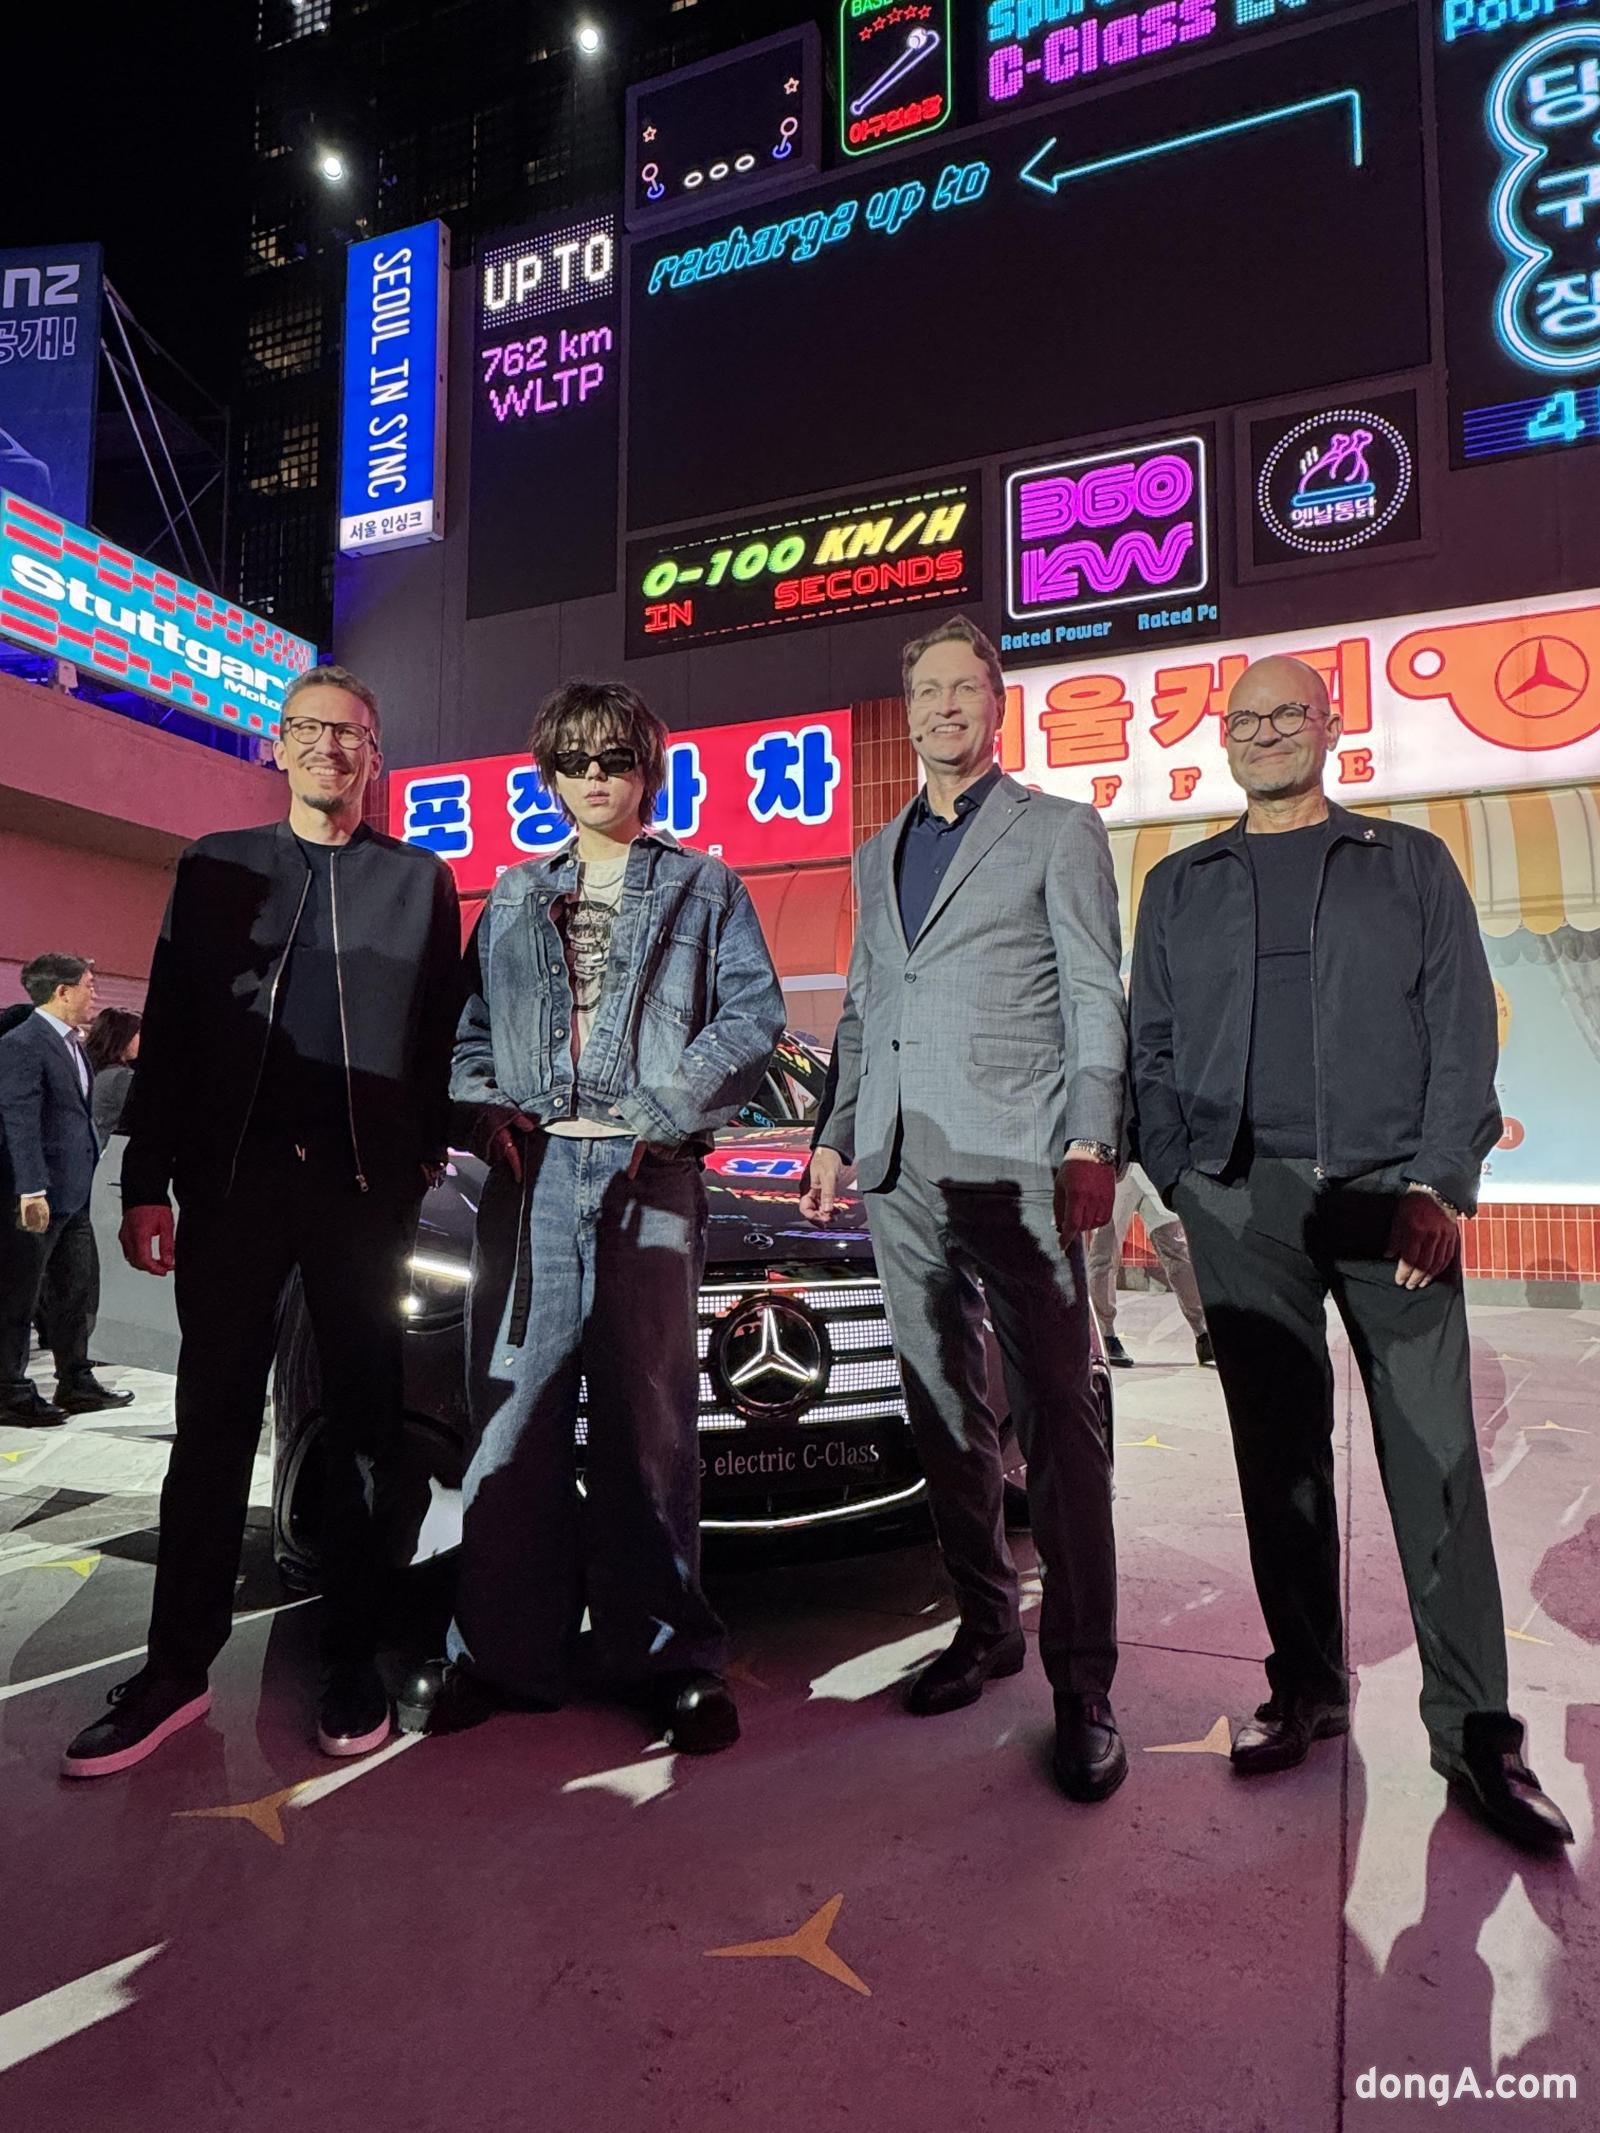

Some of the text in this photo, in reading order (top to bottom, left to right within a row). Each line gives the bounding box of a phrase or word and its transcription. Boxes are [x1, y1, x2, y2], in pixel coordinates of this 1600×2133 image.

[988, 0, 1217, 101] C-Class
[648, 161, 990, 294] recharge up to
[486, 234, 611, 310] UP TO
[367, 248, 412, 498] SEOUL IN SYNC
[482, 326, 612, 382] 762 km
[490, 362, 604, 421] WLTP
[350, 511, 422, 540] 서울 인싱크
[1020, 455, 1193, 540] 360
[1290, 496, 1378, 529] 옛날통닭
[642, 503, 966, 597] 0-100 KM/H
[11, 554, 290, 691] Stuttgar
[644, 550, 964, 633] IN SECONDS
[1001, 628, 1051, 650] Rated
[1055, 620, 1112, 643] Power
[1138, 607, 1192, 630] Rated
[714, 1447, 796, 1476] electric
[803, 1441, 881, 1469] C-Class
